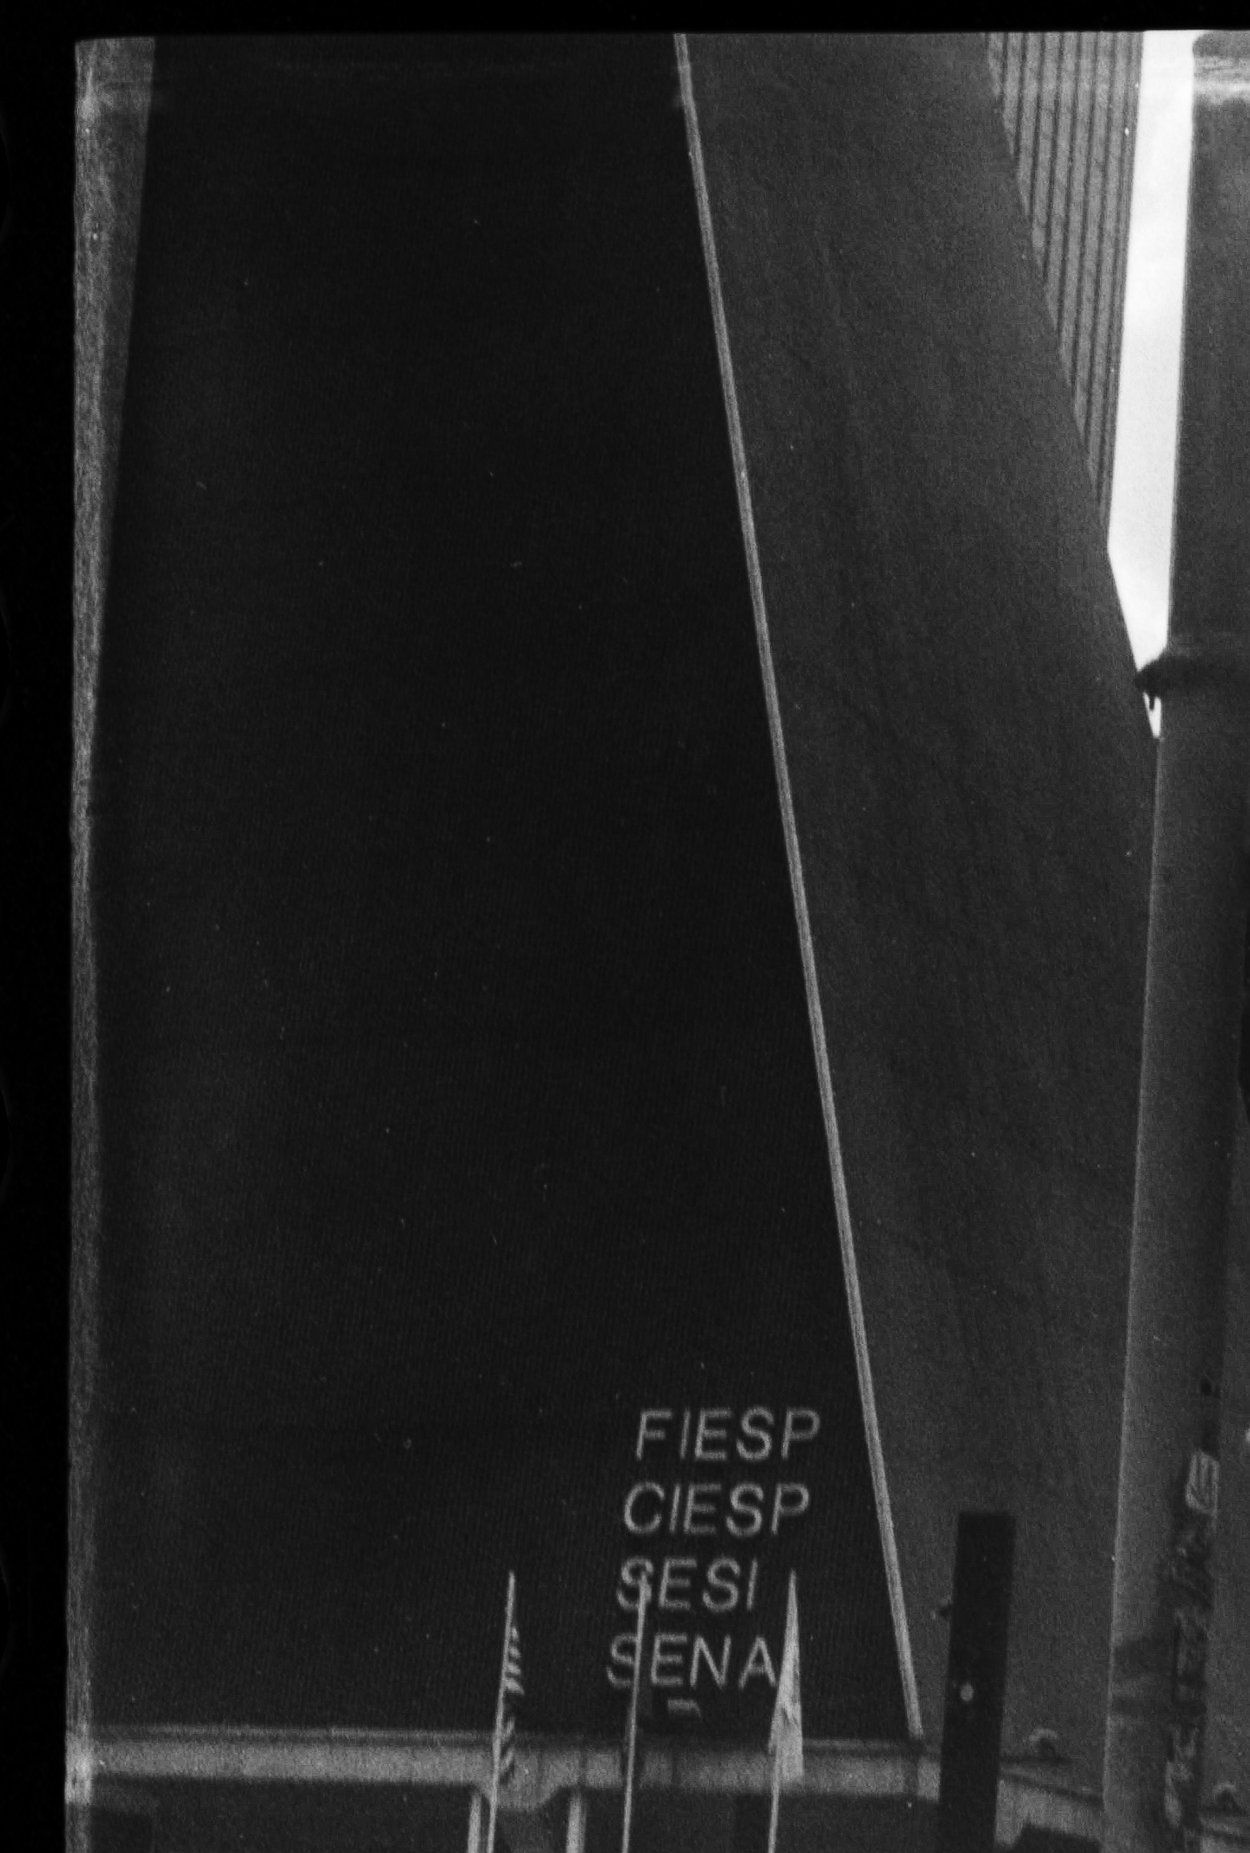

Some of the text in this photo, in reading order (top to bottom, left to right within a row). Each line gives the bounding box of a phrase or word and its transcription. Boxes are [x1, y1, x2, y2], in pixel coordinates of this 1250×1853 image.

[635, 1406, 821, 1461] FIESP
[623, 1481, 810, 1537] CIESP
[615, 1556, 758, 1613] SESI
[606, 1631, 782, 1689] SENA
